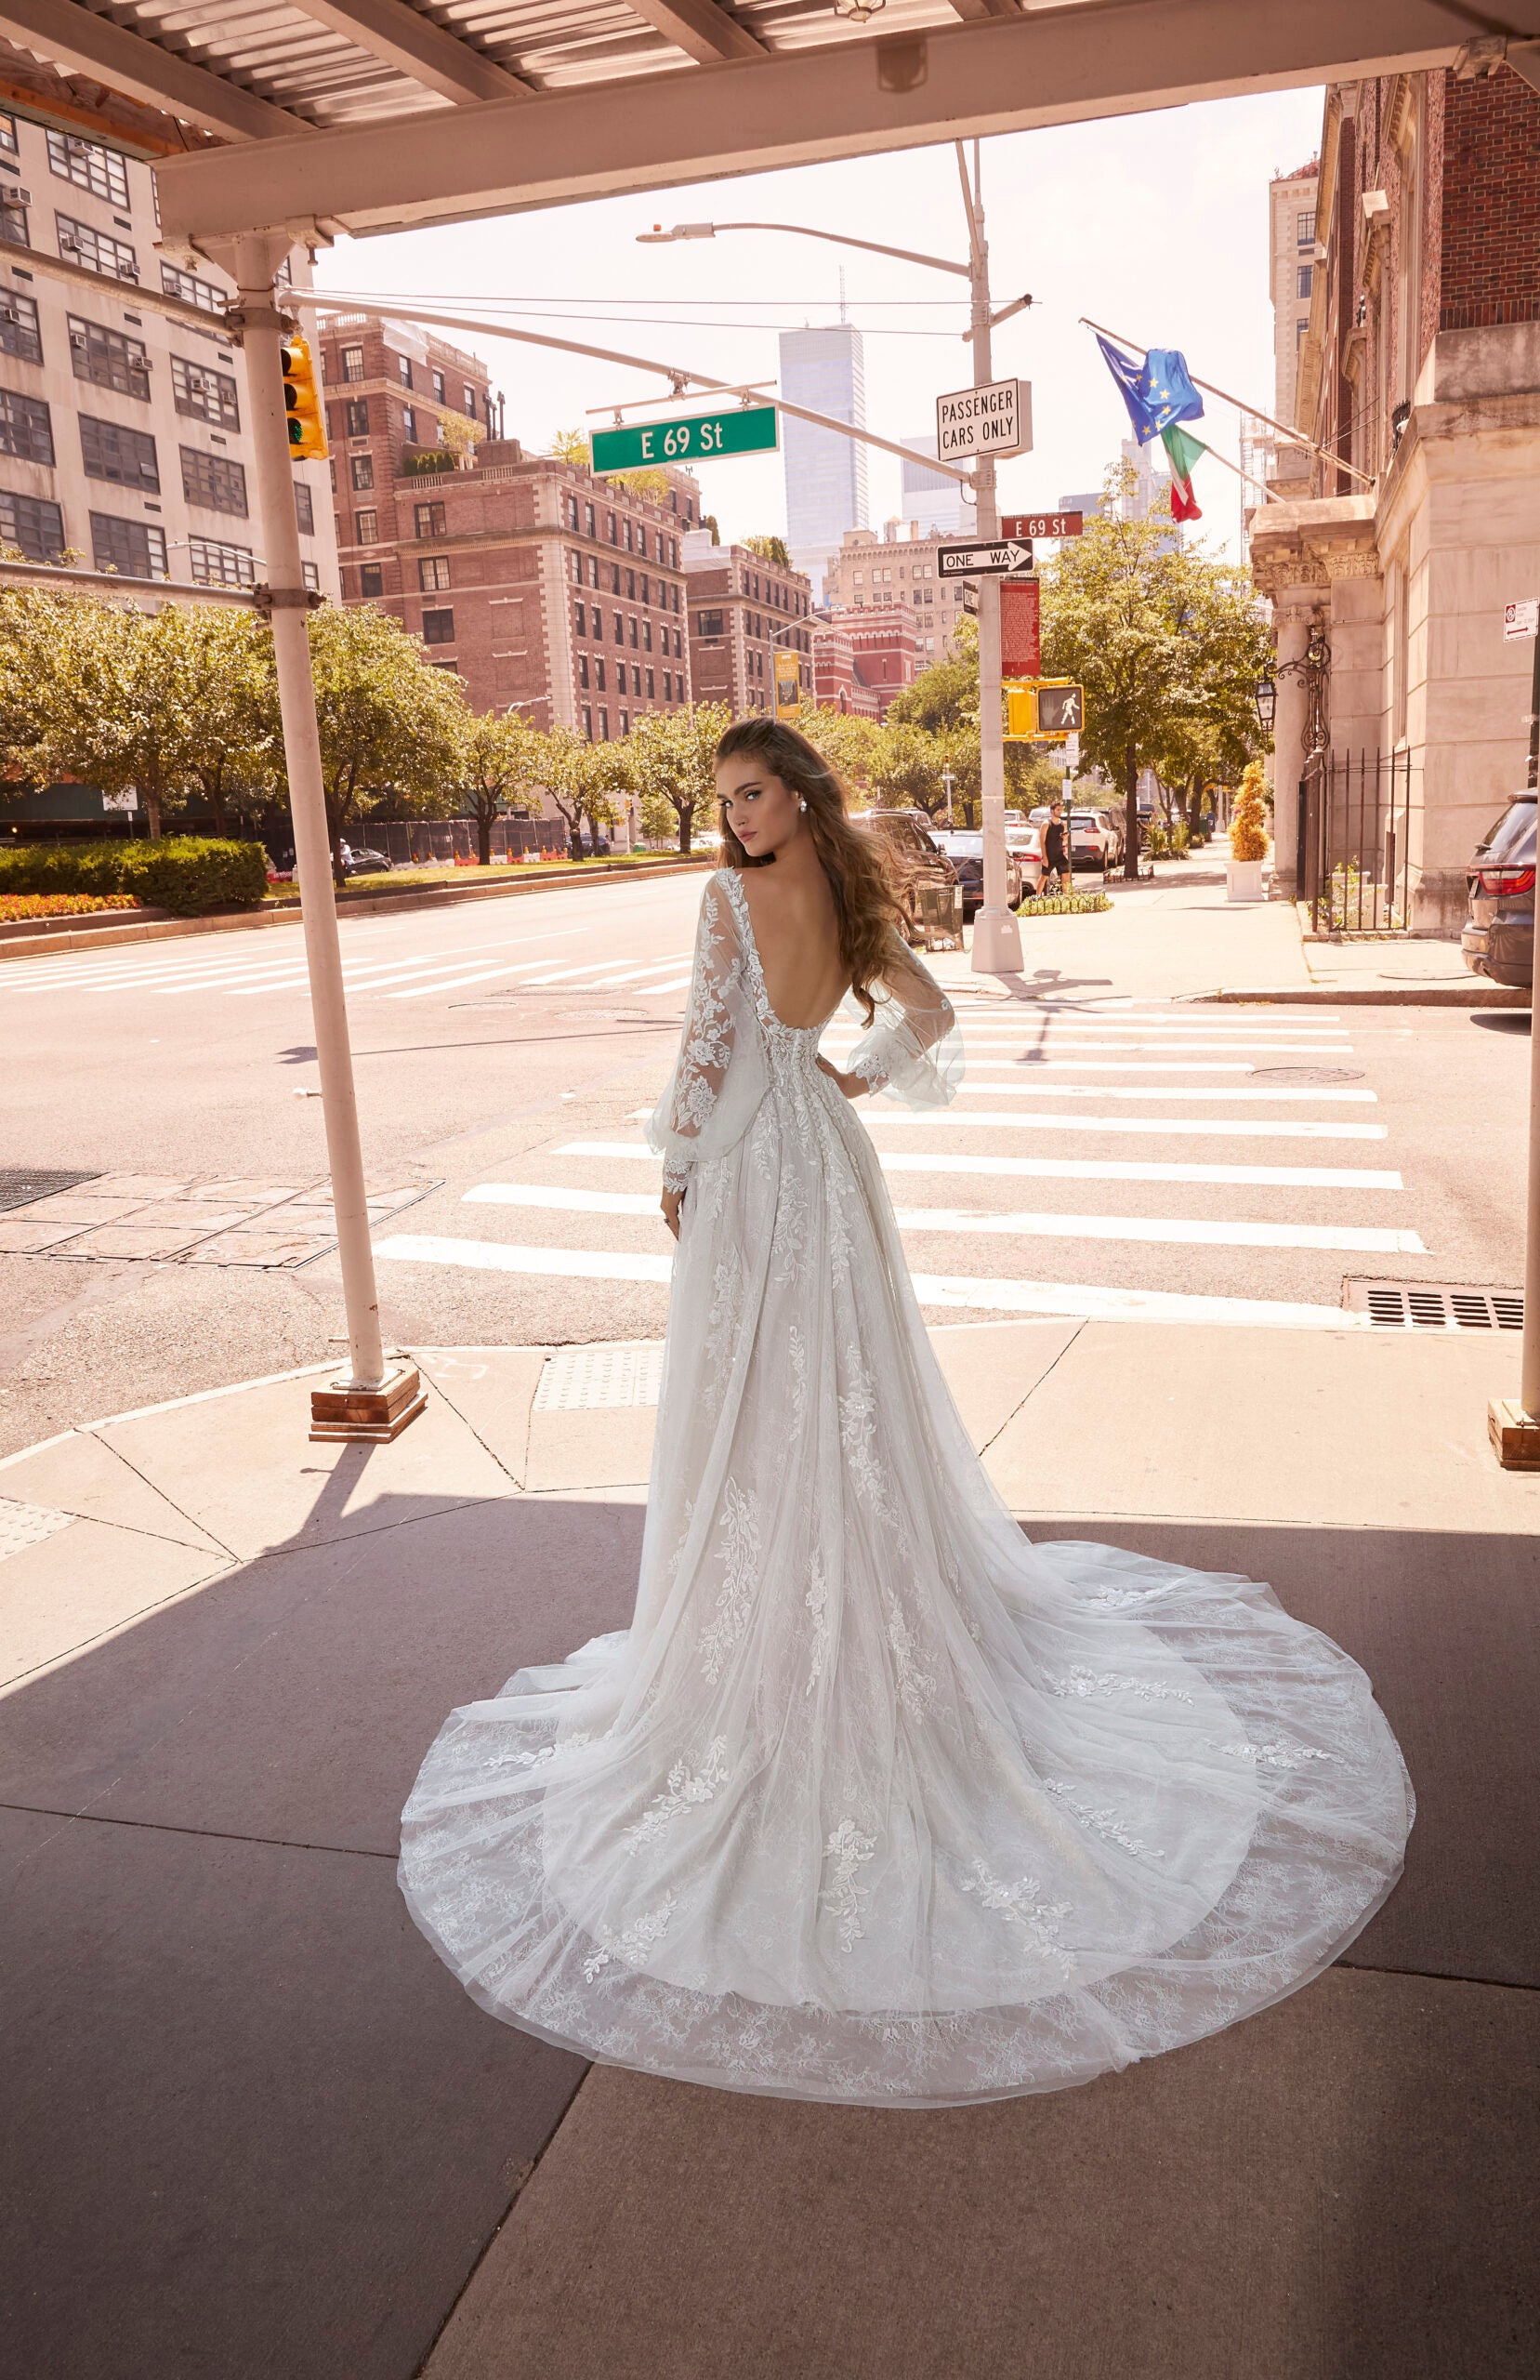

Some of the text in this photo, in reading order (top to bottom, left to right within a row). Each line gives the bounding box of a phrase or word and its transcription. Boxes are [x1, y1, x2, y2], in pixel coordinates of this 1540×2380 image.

[941, 390, 1013, 424] PASSENGER
[641, 422, 723, 459] E 69 St
[942, 416, 1014, 450] CARS ONLY
[1016, 518, 1067, 537] E 69 St
[946, 549, 1020, 568] ONE WAY
